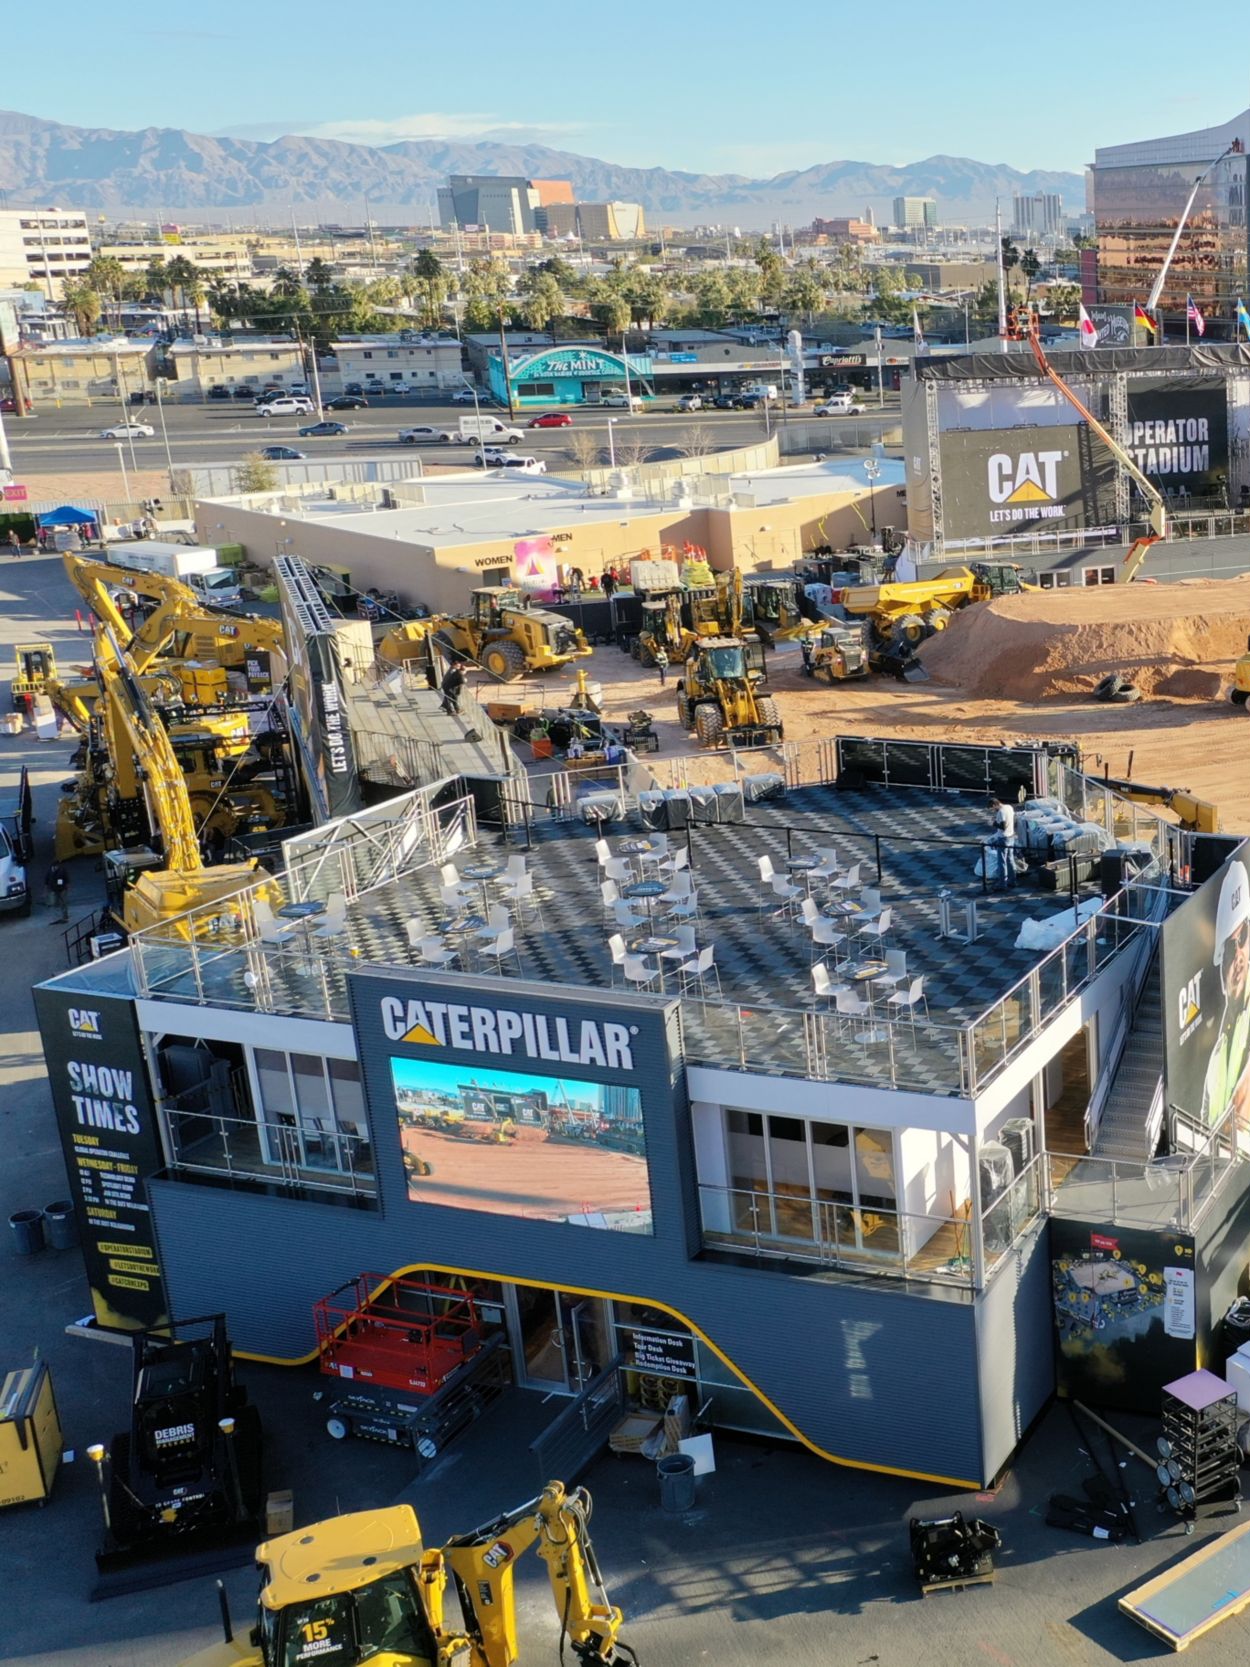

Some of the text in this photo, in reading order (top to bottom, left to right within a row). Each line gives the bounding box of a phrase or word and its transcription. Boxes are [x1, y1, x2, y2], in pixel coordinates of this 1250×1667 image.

[547, 359, 605, 371] THE MINT
[987, 450, 1063, 504] CAT
[990, 509, 1011, 523] LET'S
[1011, 507, 1024, 519] DO
[1024, 506, 1040, 519] THE
[474, 555, 513, 567] WOMEN
[219, 625, 235, 636] CAT
[325, 712, 341, 731] THE
[328, 731, 343, 747] DO
[330, 746, 348, 774] LET'S
[1231, 886, 1242, 911] CAT
[1178, 970, 1203, 1030] CAT
[68, 1008, 99, 1032] CAT
[380, 996, 635, 1070] CATERPILLAR
[67, 1061, 132, 1101] SHOW
[72, 1095, 140, 1135] TIMES
[72, 1133, 99, 1146] TUESDAY
[76, 1157, 113, 1171] WEDNESDAY
[116, 1163, 138, 1174] FRIDAY
[86, 1206, 117, 1219] SATURDAY
[632, 1333, 684, 1347] Information Desk
[634, 1342, 663, 1353] Tour Desk
[635, 1351, 696, 1369] Big Ticket Giveaway
[635, 1359, 687, 1374] Redemption Desk
[154, 1423, 195, 1440] DEBRIS
[156, 1432, 195, 1445] MANAGEMENT
[157, 1437, 195, 1449] PACKAGE
[483, 1543, 507, 1568] CAT
[302, 1617, 335, 1642] 15%
[296, 1643, 343, 1661] PERFORMANCE
[303, 1638, 331, 1652] MORE
